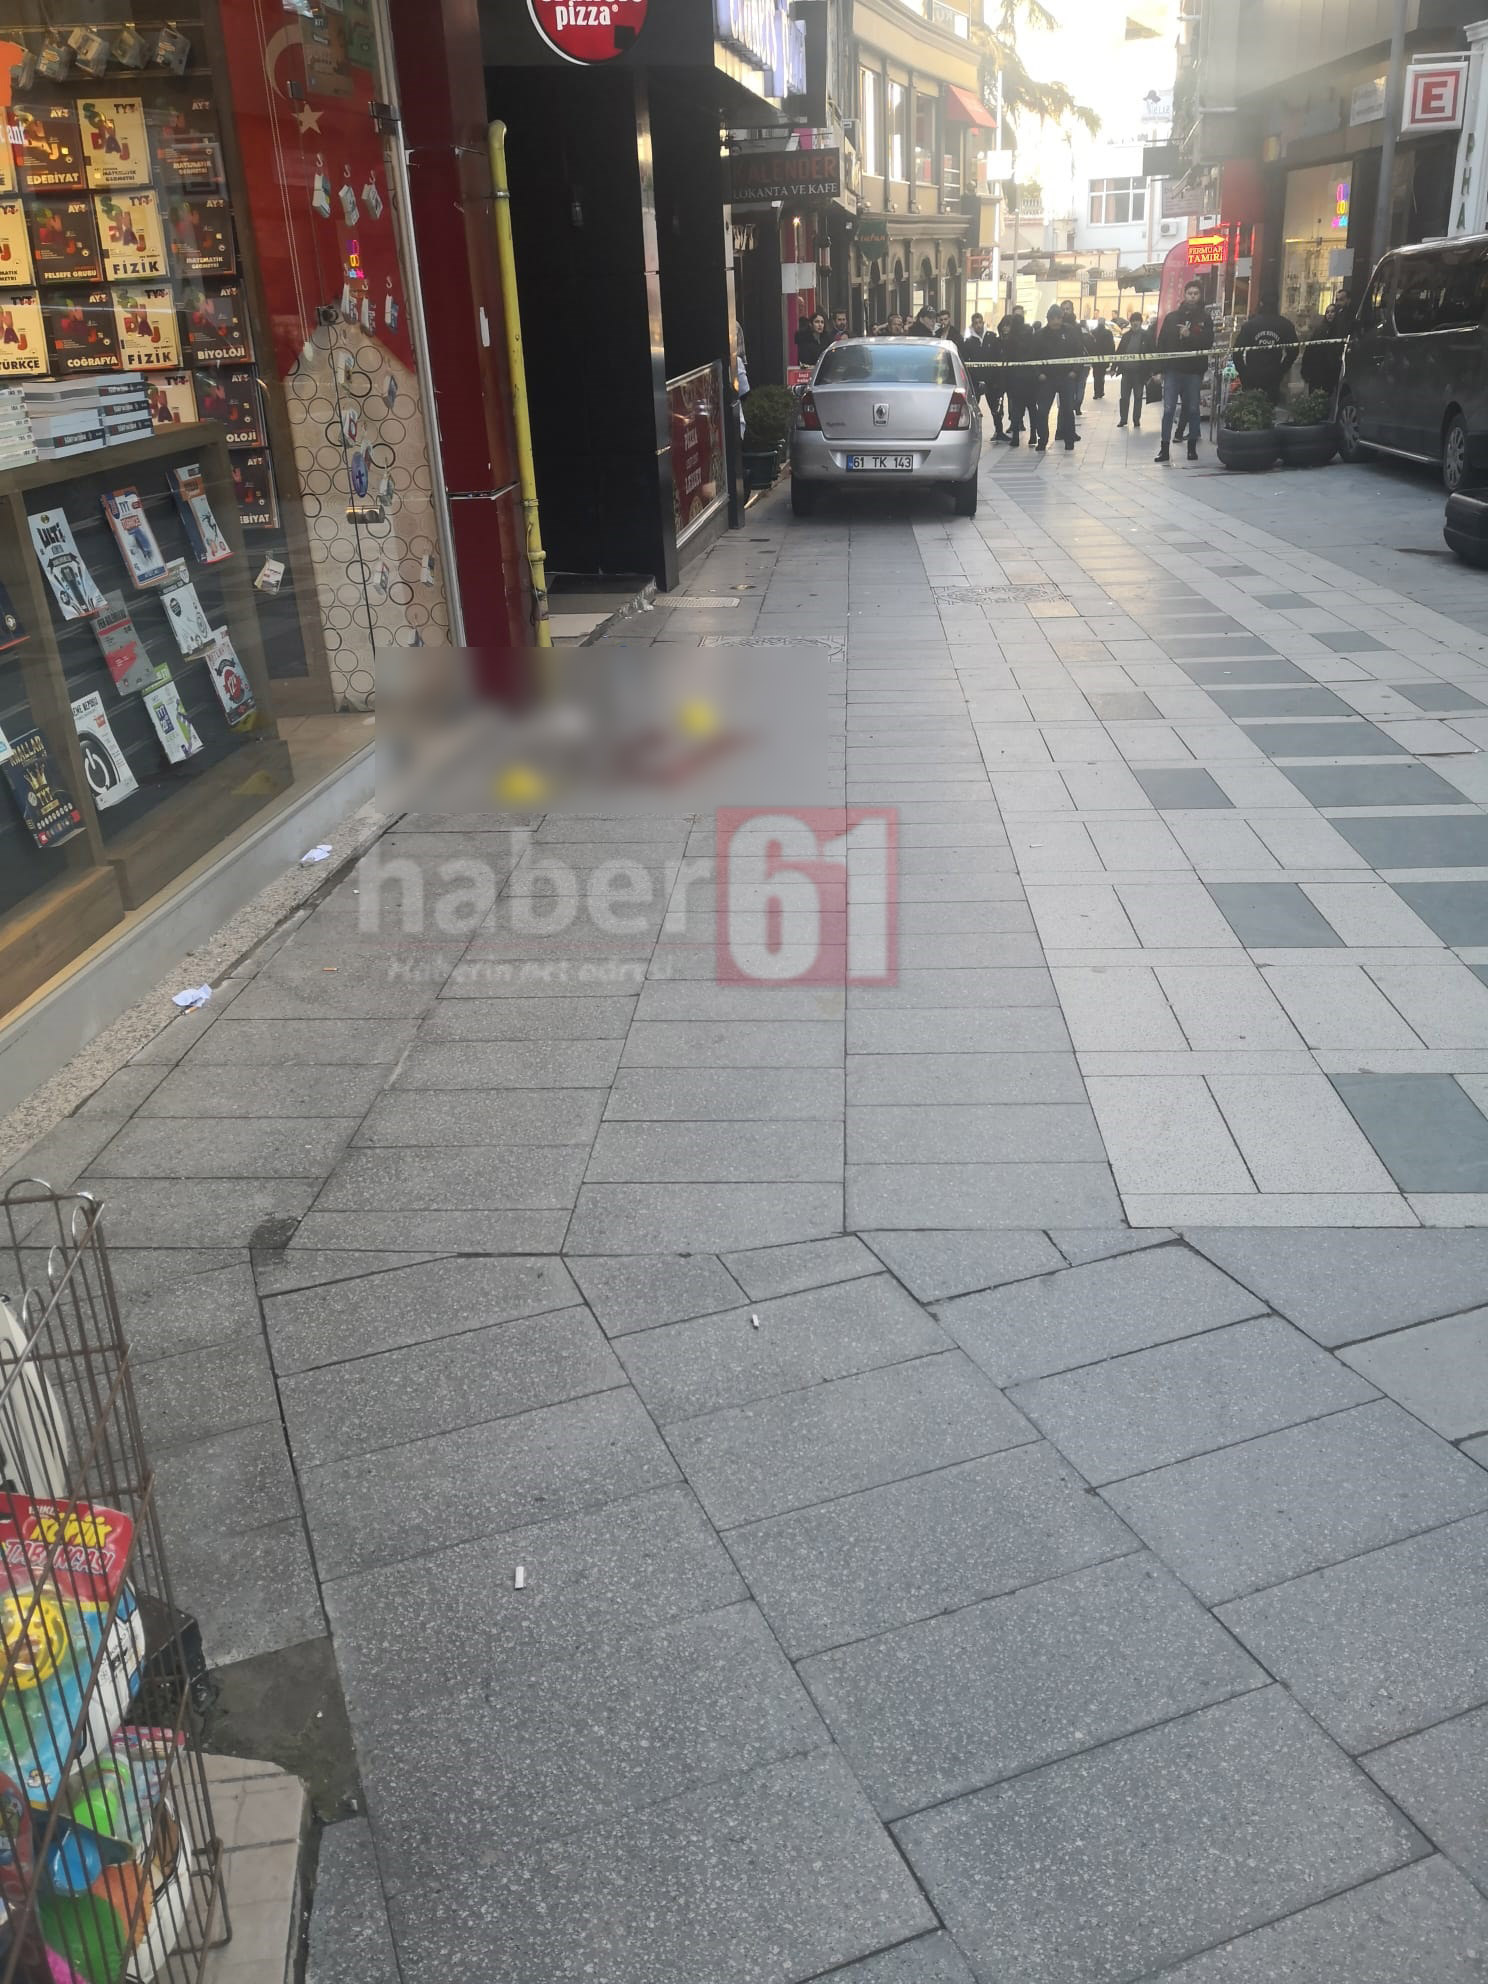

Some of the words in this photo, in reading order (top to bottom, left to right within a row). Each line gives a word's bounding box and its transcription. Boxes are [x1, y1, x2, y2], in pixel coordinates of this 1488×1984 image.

[555, 0, 611, 30] pizza
[1421, 80, 1449, 115] E
[26, 172, 80, 185] EDEBİYAT
[790, 184, 807, 195] VE
[808, 182, 838, 195] KAFE
[112, 258, 160, 275] FİZİK
[127, 350, 172, 366] FİZİK
[197, 344, 246, 360] BİYOLOJİ
[67, 356, 119, 368] COĞRAFYA
[225, 429, 256, 443] OLOJİ
[853, 456, 865, 468] 61
[872, 456, 887, 468] TK
[894, 456, 911, 468] 143
